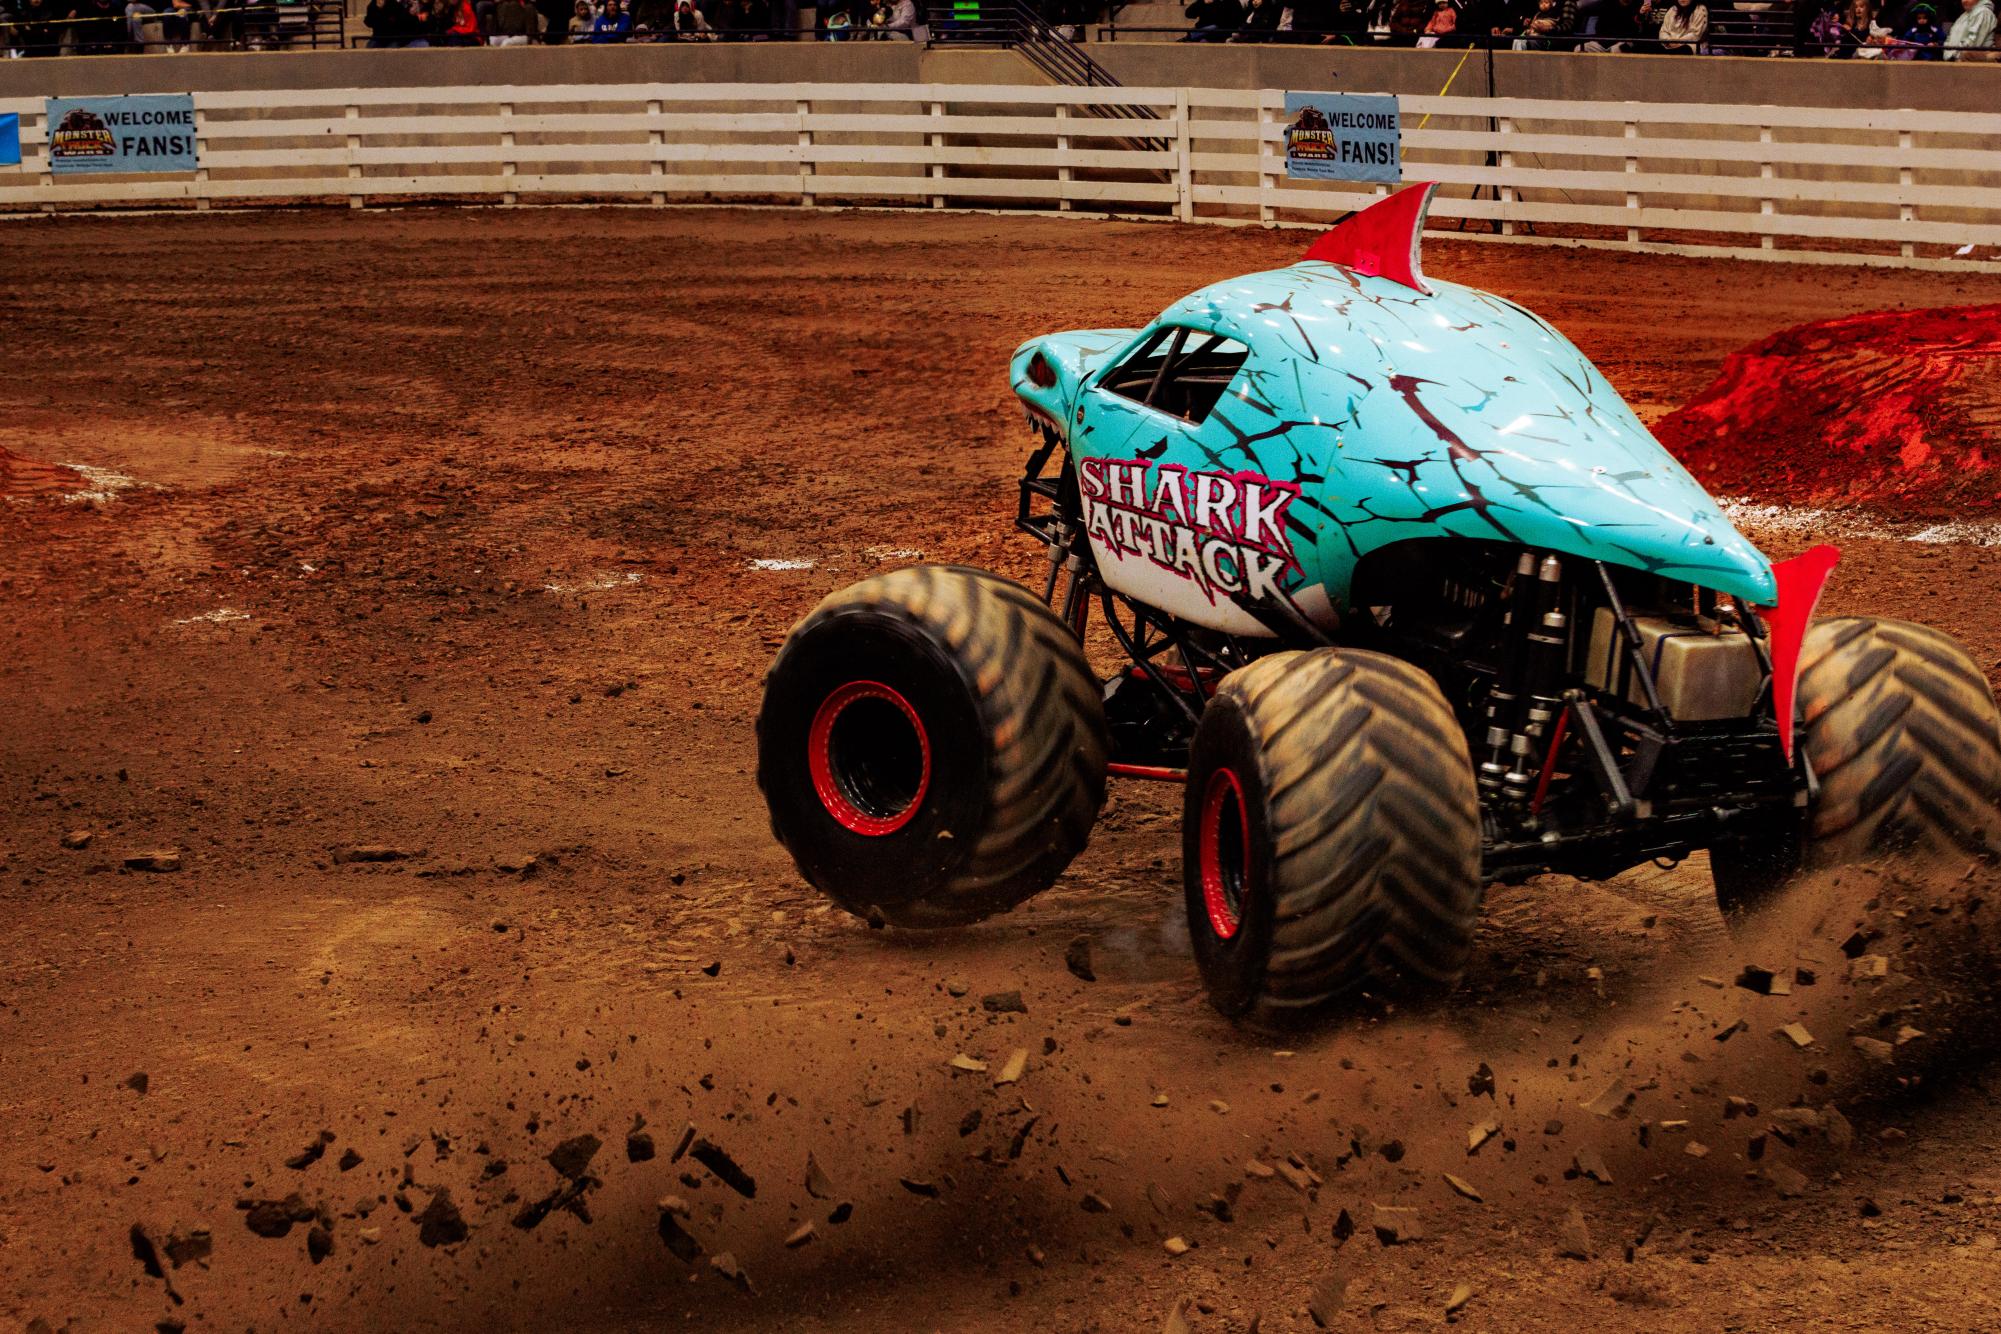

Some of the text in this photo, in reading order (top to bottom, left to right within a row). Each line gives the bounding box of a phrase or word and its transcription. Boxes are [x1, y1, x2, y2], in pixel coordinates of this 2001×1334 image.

[104, 110, 193, 126] WELCOME
[1328, 112, 1396, 130] WELCOME
[53, 129, 114, 146] MONSTER
[122, 136, 193, 157] FANS!
[1289, 129, 1335, 148] MONSTER
[1341, 140, 1395, 166] FANS!
[1080, 458, 1299, 561] SHARK
[1088, 500, 1303, 612] ATTACK
